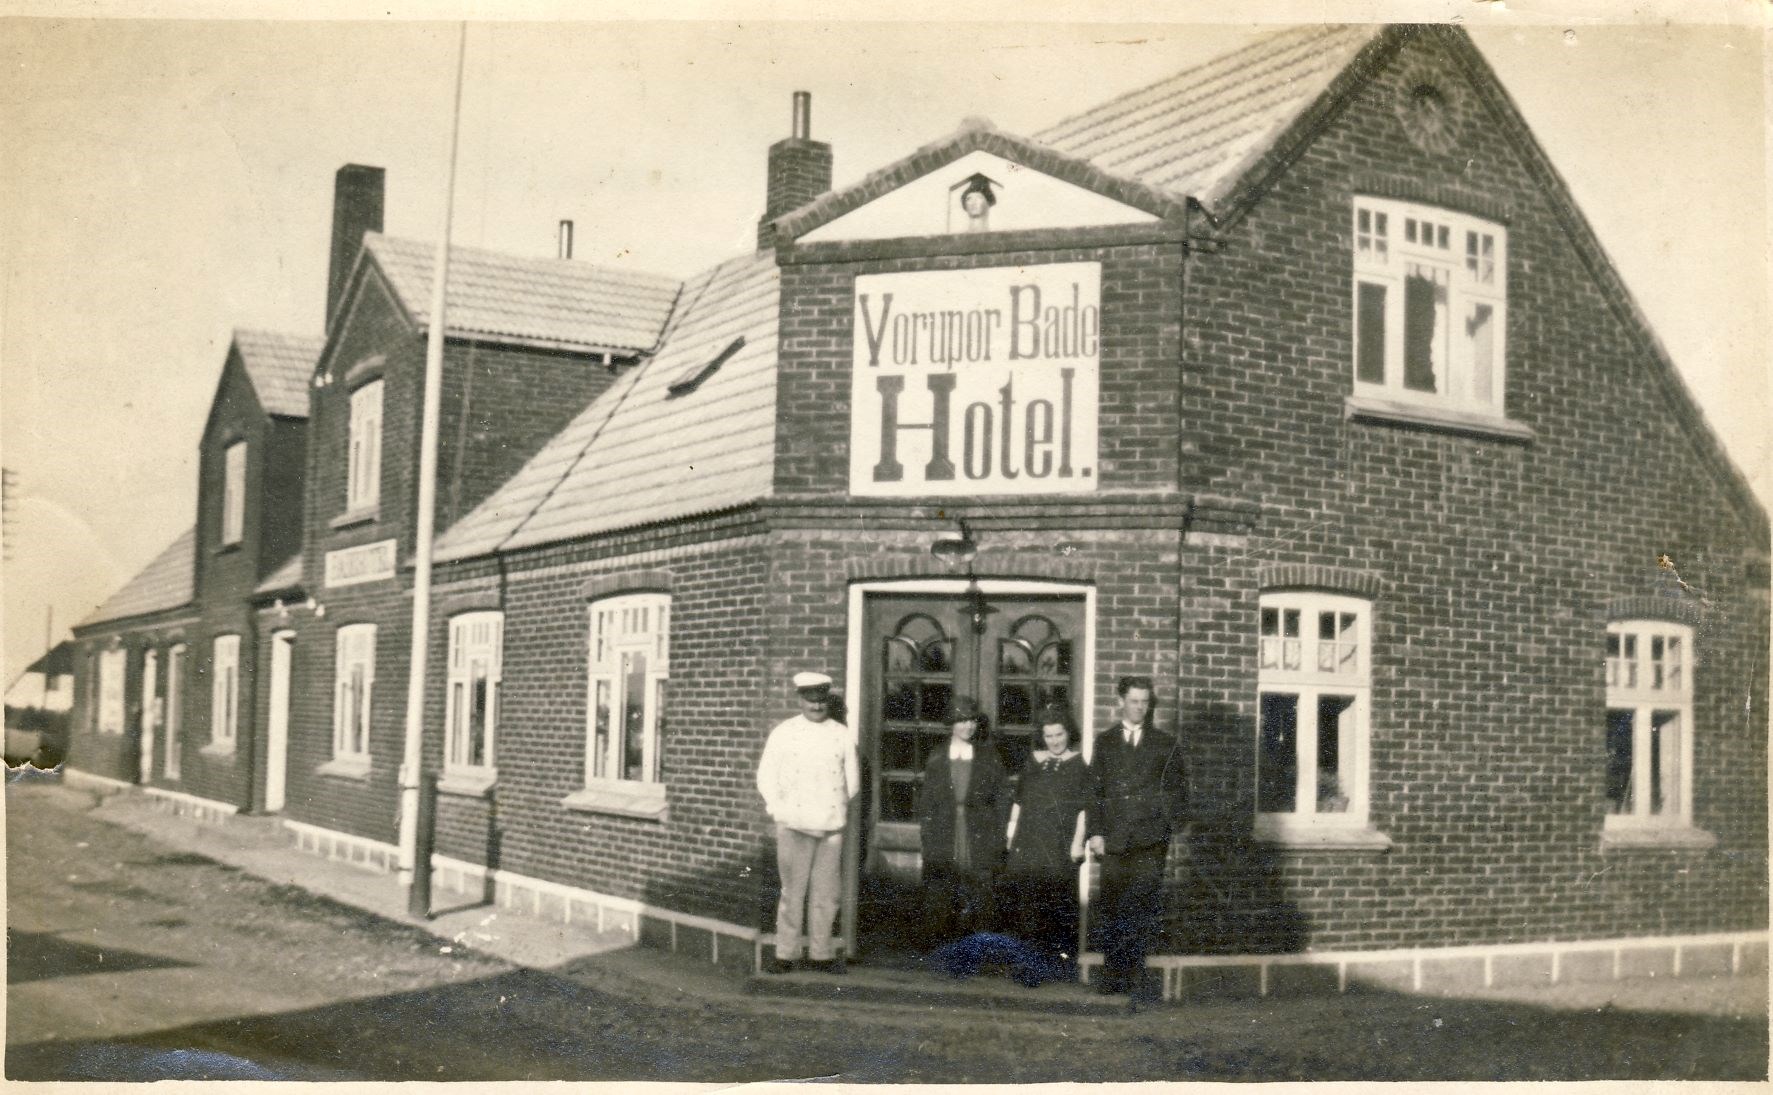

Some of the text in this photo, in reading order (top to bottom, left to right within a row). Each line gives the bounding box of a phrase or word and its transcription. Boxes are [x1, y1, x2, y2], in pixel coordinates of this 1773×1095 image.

[859, 282, 1098, 370] Vorupor Bade
[872, 367, 1092, 482] Hotel.
